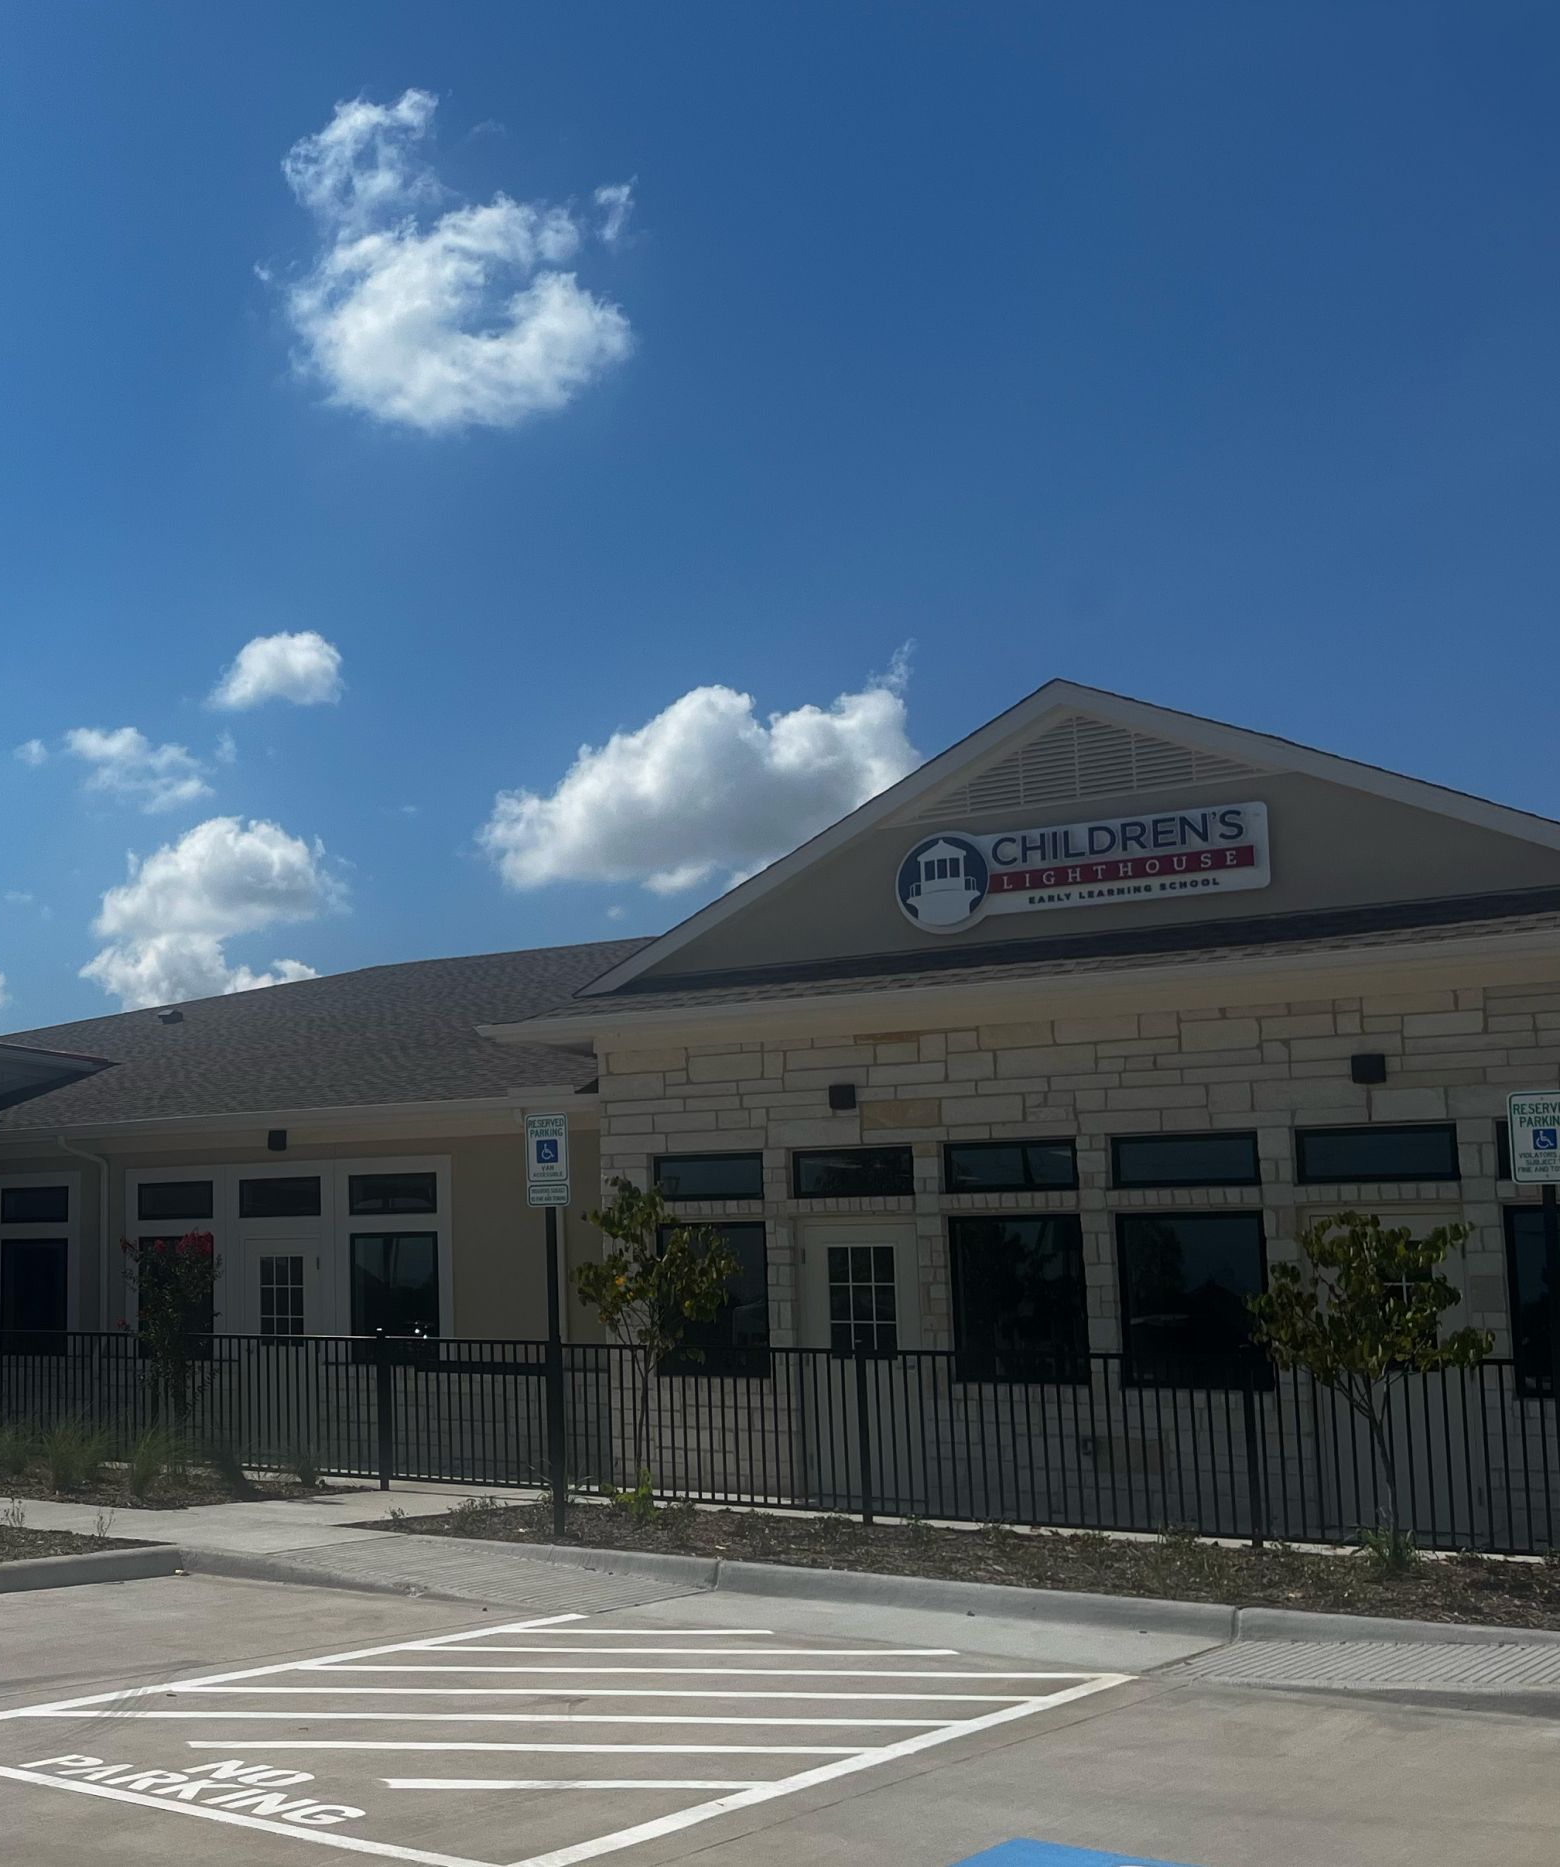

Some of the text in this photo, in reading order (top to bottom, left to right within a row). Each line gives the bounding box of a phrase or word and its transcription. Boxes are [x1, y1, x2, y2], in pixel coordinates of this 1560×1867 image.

[991, 808, 1244, 867] CHILDREN'S
[1002, 849, 1239, 890] LIGHTHOUSE
[1028, 877, 1220, 905] EARLY LEARNING SCHOOL
[528, 1118, 564, 1129] RESERVED
[530, 1128, 564, 1138] PARKING
[183, 1759, 315, 1787] NO
[19, 1754, 366, 1825] PARKING
